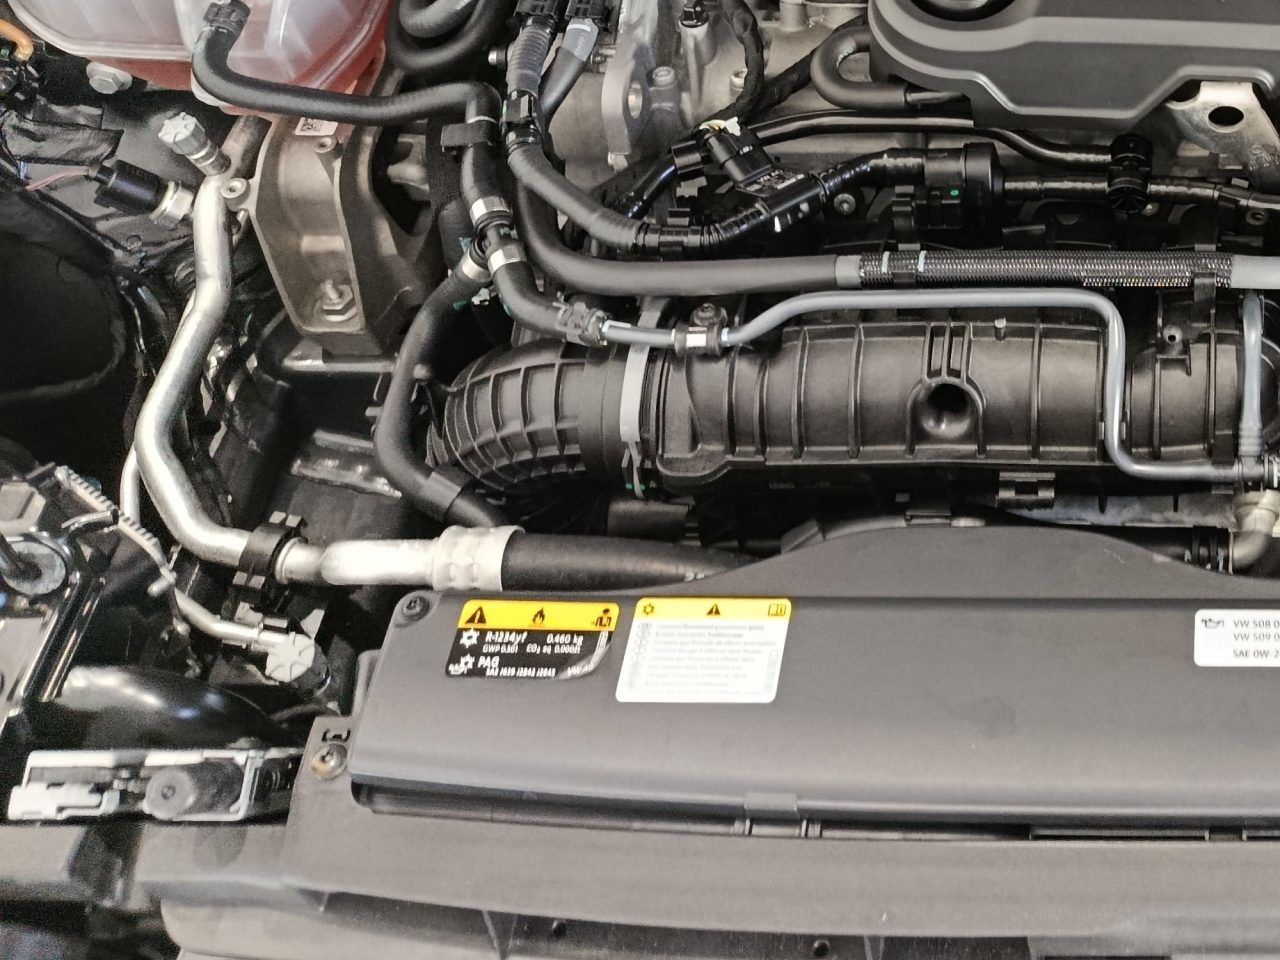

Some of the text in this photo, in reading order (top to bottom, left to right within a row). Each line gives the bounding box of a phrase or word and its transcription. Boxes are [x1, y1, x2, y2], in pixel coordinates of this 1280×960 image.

[1233, 620, 1250, 628] VW
[1253, 620, 1271, 628] 508
[485, 631, 528, 644] R-1234yf
[1233, 632, 1250, 641] VW
[1253, 632, 1271, 641] 509
[1233, 650, 1250, 658] SAE
[477, 656, 500, 669] PAG
